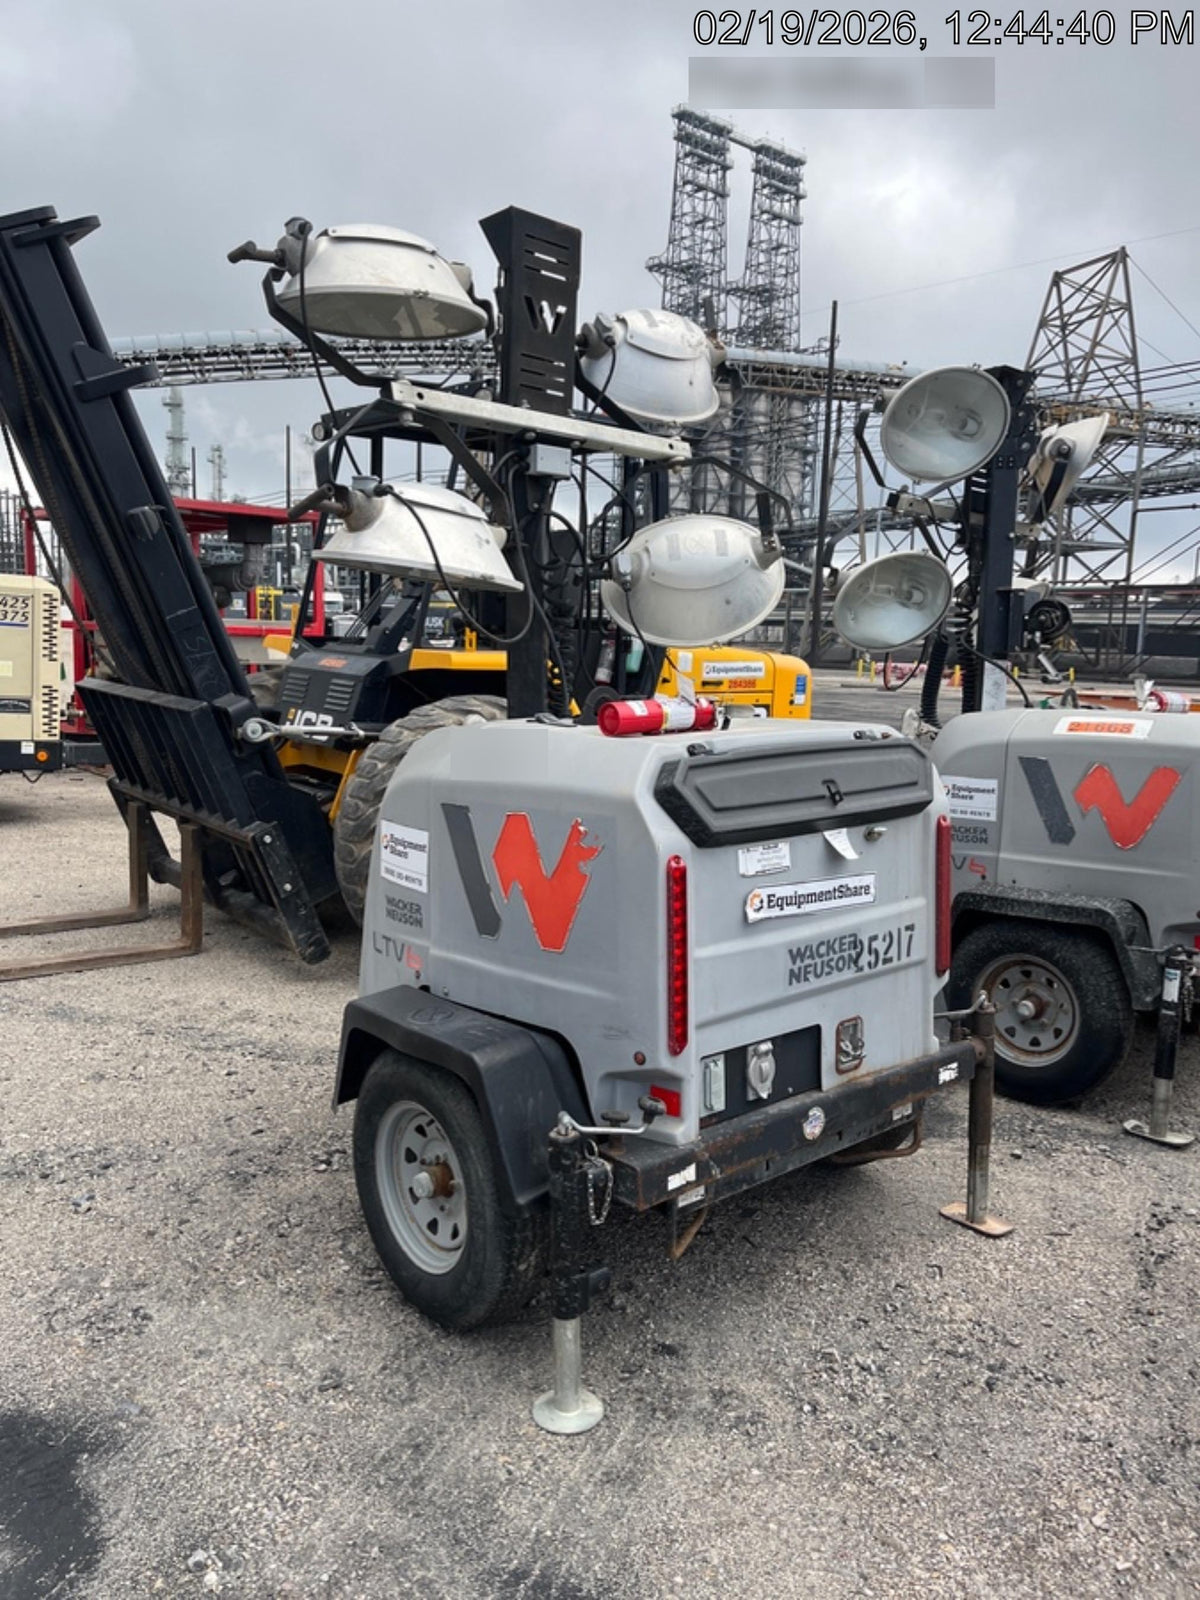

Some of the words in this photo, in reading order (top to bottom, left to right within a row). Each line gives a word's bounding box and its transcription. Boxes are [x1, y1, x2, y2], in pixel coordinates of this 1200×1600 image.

[711, 664, 764, 675] EquipmentShare
[951, 783, 996, 795] Equipment
[950, 791, 975, 801] Share
[950, 825, 987, 835] ACKER
[950, 834, 988, 844] EUSON
[766, 882, 872, 911] EquipmentShare
[385, 894, 422, 915] WACKER
[385, 906, 424, 929] NEUSON
[787, 932, 859, 966] WACKER
